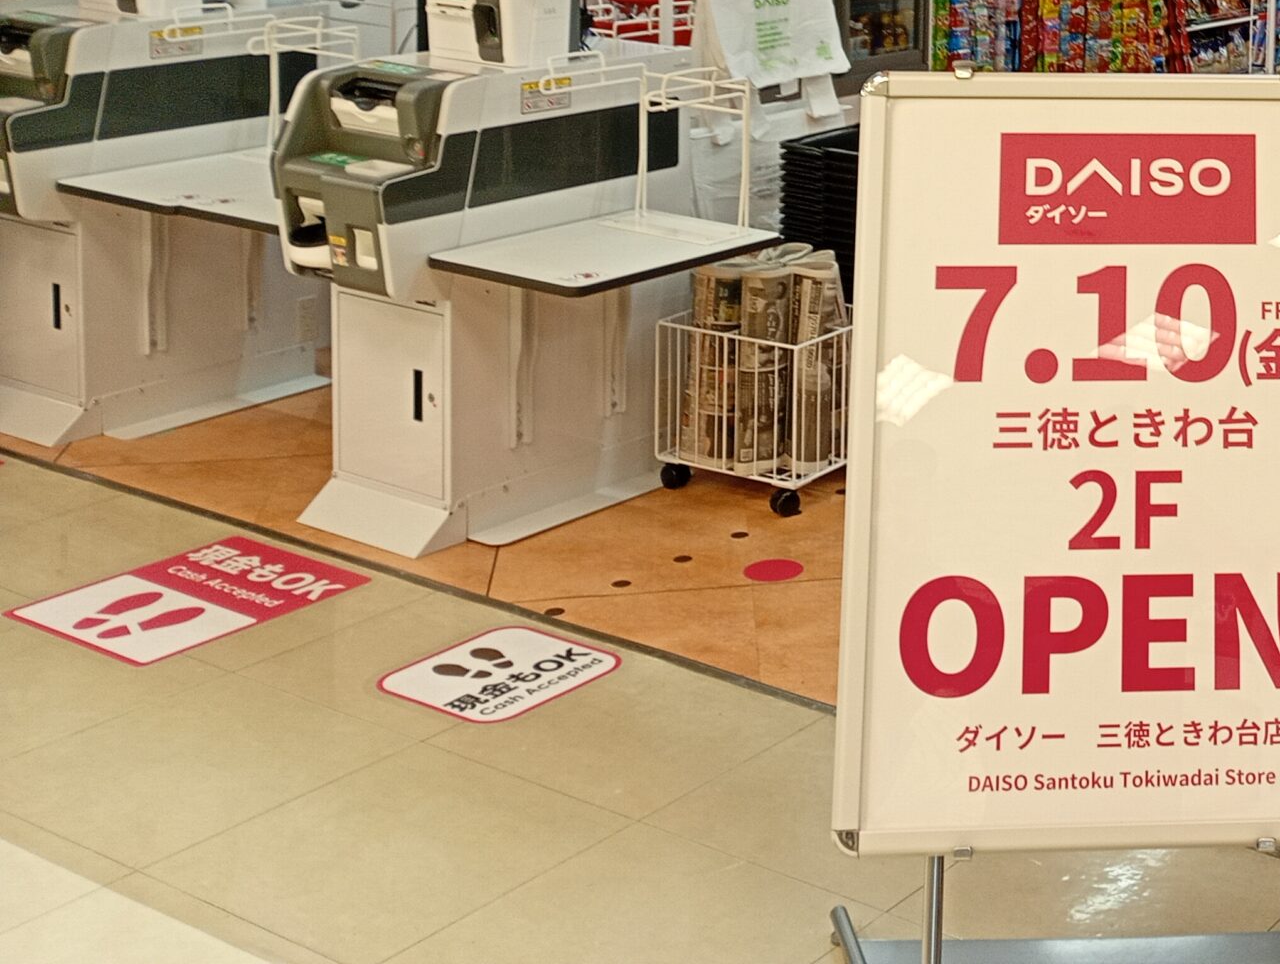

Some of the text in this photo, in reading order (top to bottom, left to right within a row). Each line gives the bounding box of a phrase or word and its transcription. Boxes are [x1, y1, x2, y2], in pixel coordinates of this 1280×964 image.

[1024, 157, 1232, 197] DAISO
[1025, 203, 1107, 225] ダイソー
[935, 263, 1237, 384] 7.10
[992, 406, 1259, 451] 三徳ときわ台
[1068, 469, 1183, 550] 2F
[167, 565, 285, 608] Cash Accepted
[186, 544, 346, 602] 現金もOK
[443, 647, 593, 713] 現金もOK
[479, 657, 604, 716] Cash Accepted
[956, 723, 1066, 753] ダイソー
[968, 768, 1276, 792] DAISO Santoku Tokiwadai Store
